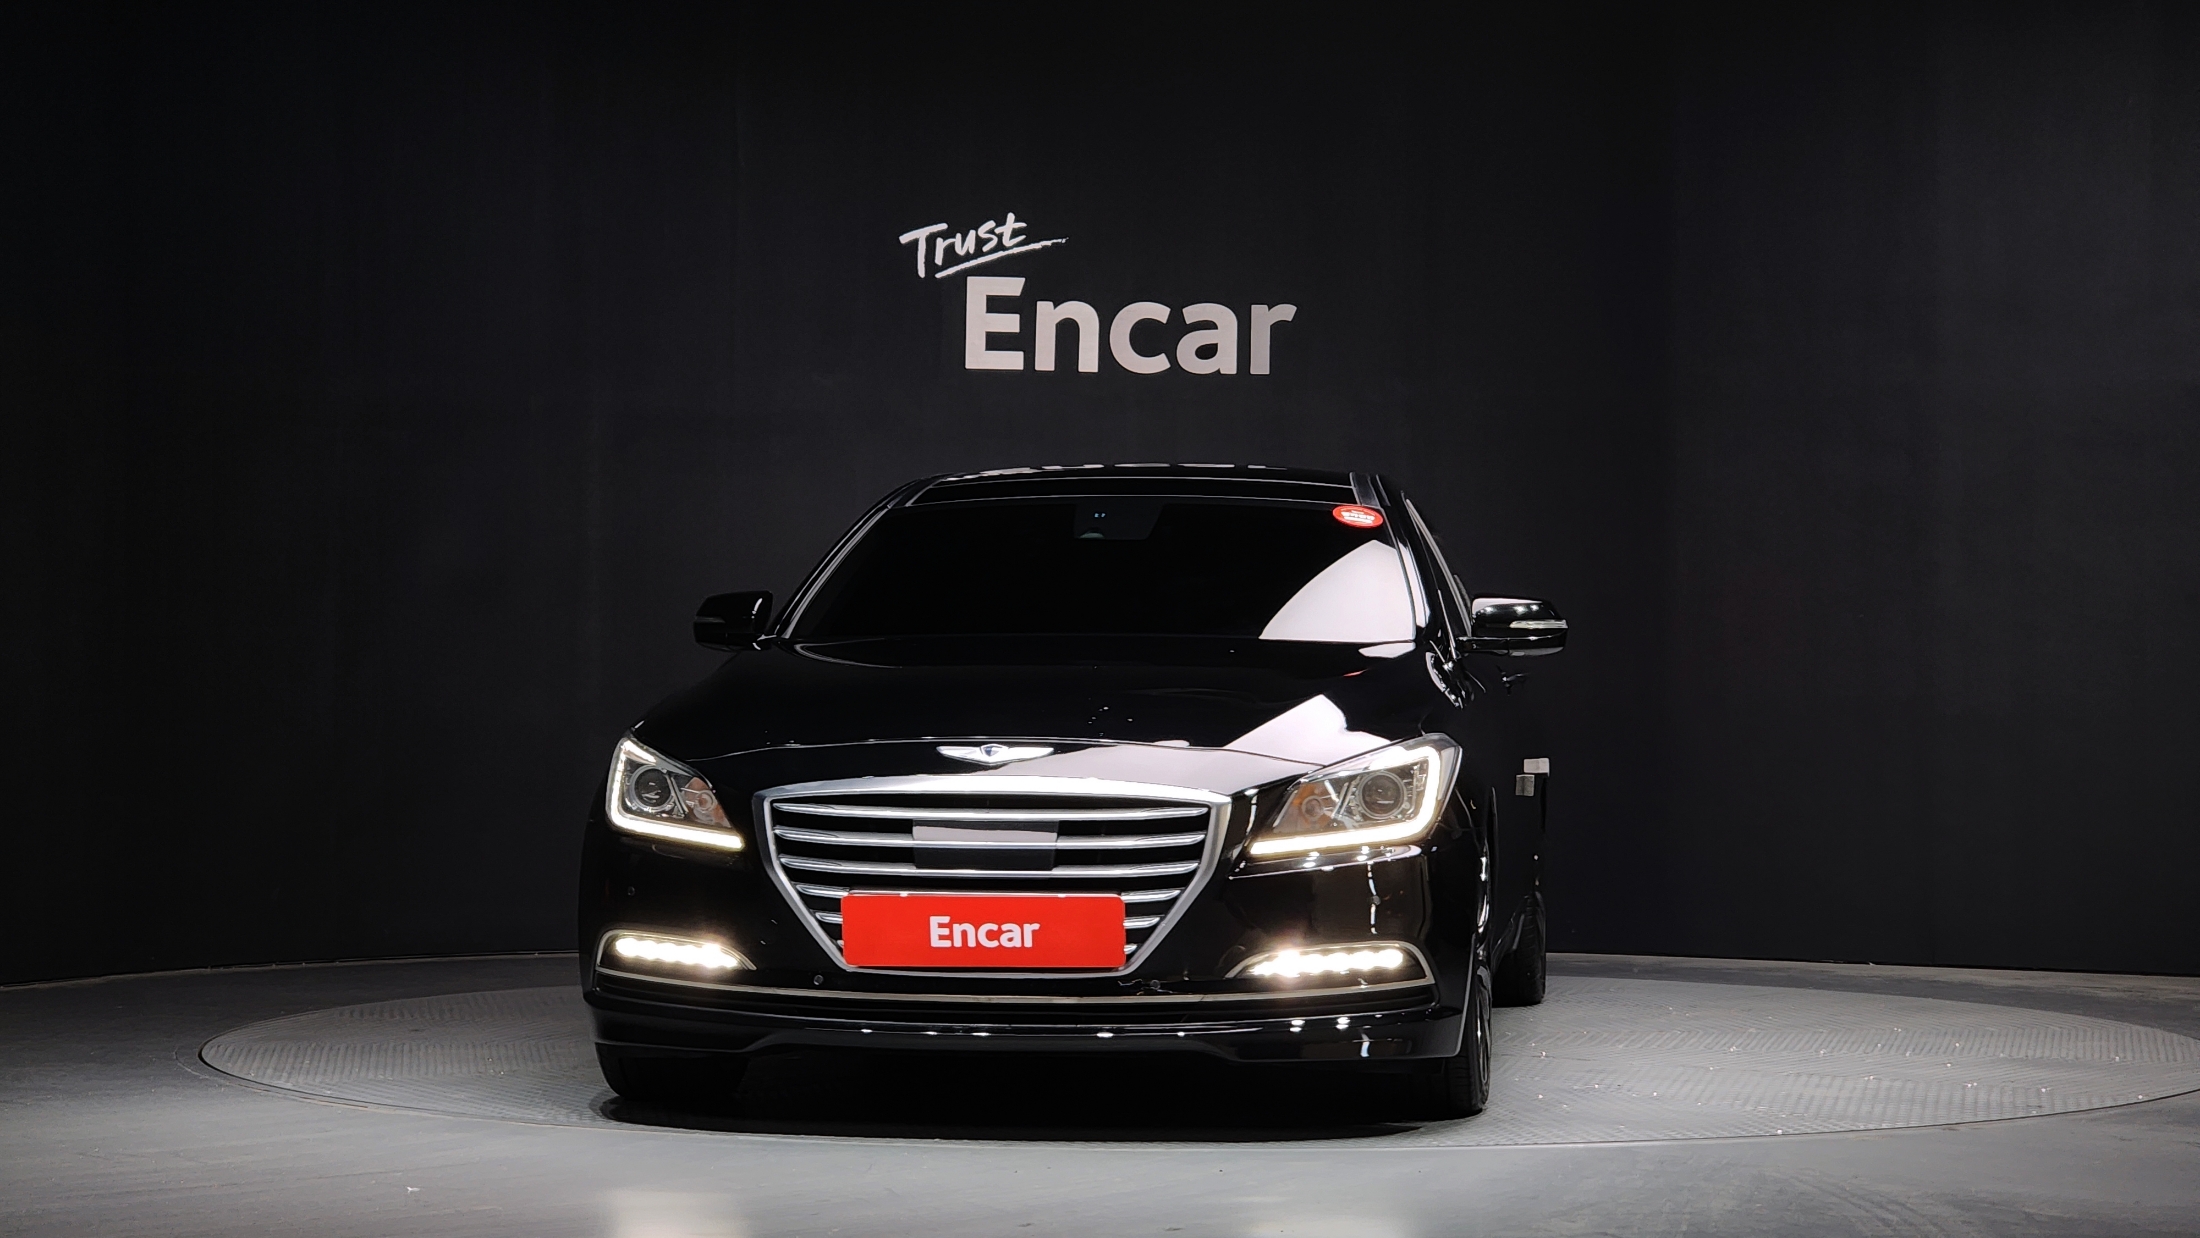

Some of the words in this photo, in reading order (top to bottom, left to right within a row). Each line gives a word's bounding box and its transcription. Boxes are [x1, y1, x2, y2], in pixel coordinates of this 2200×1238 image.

[898, 211, 1029, 279] Trust
[964, 275, 1298, 375] Encar
[929, 915, 1041, 949] Encar
